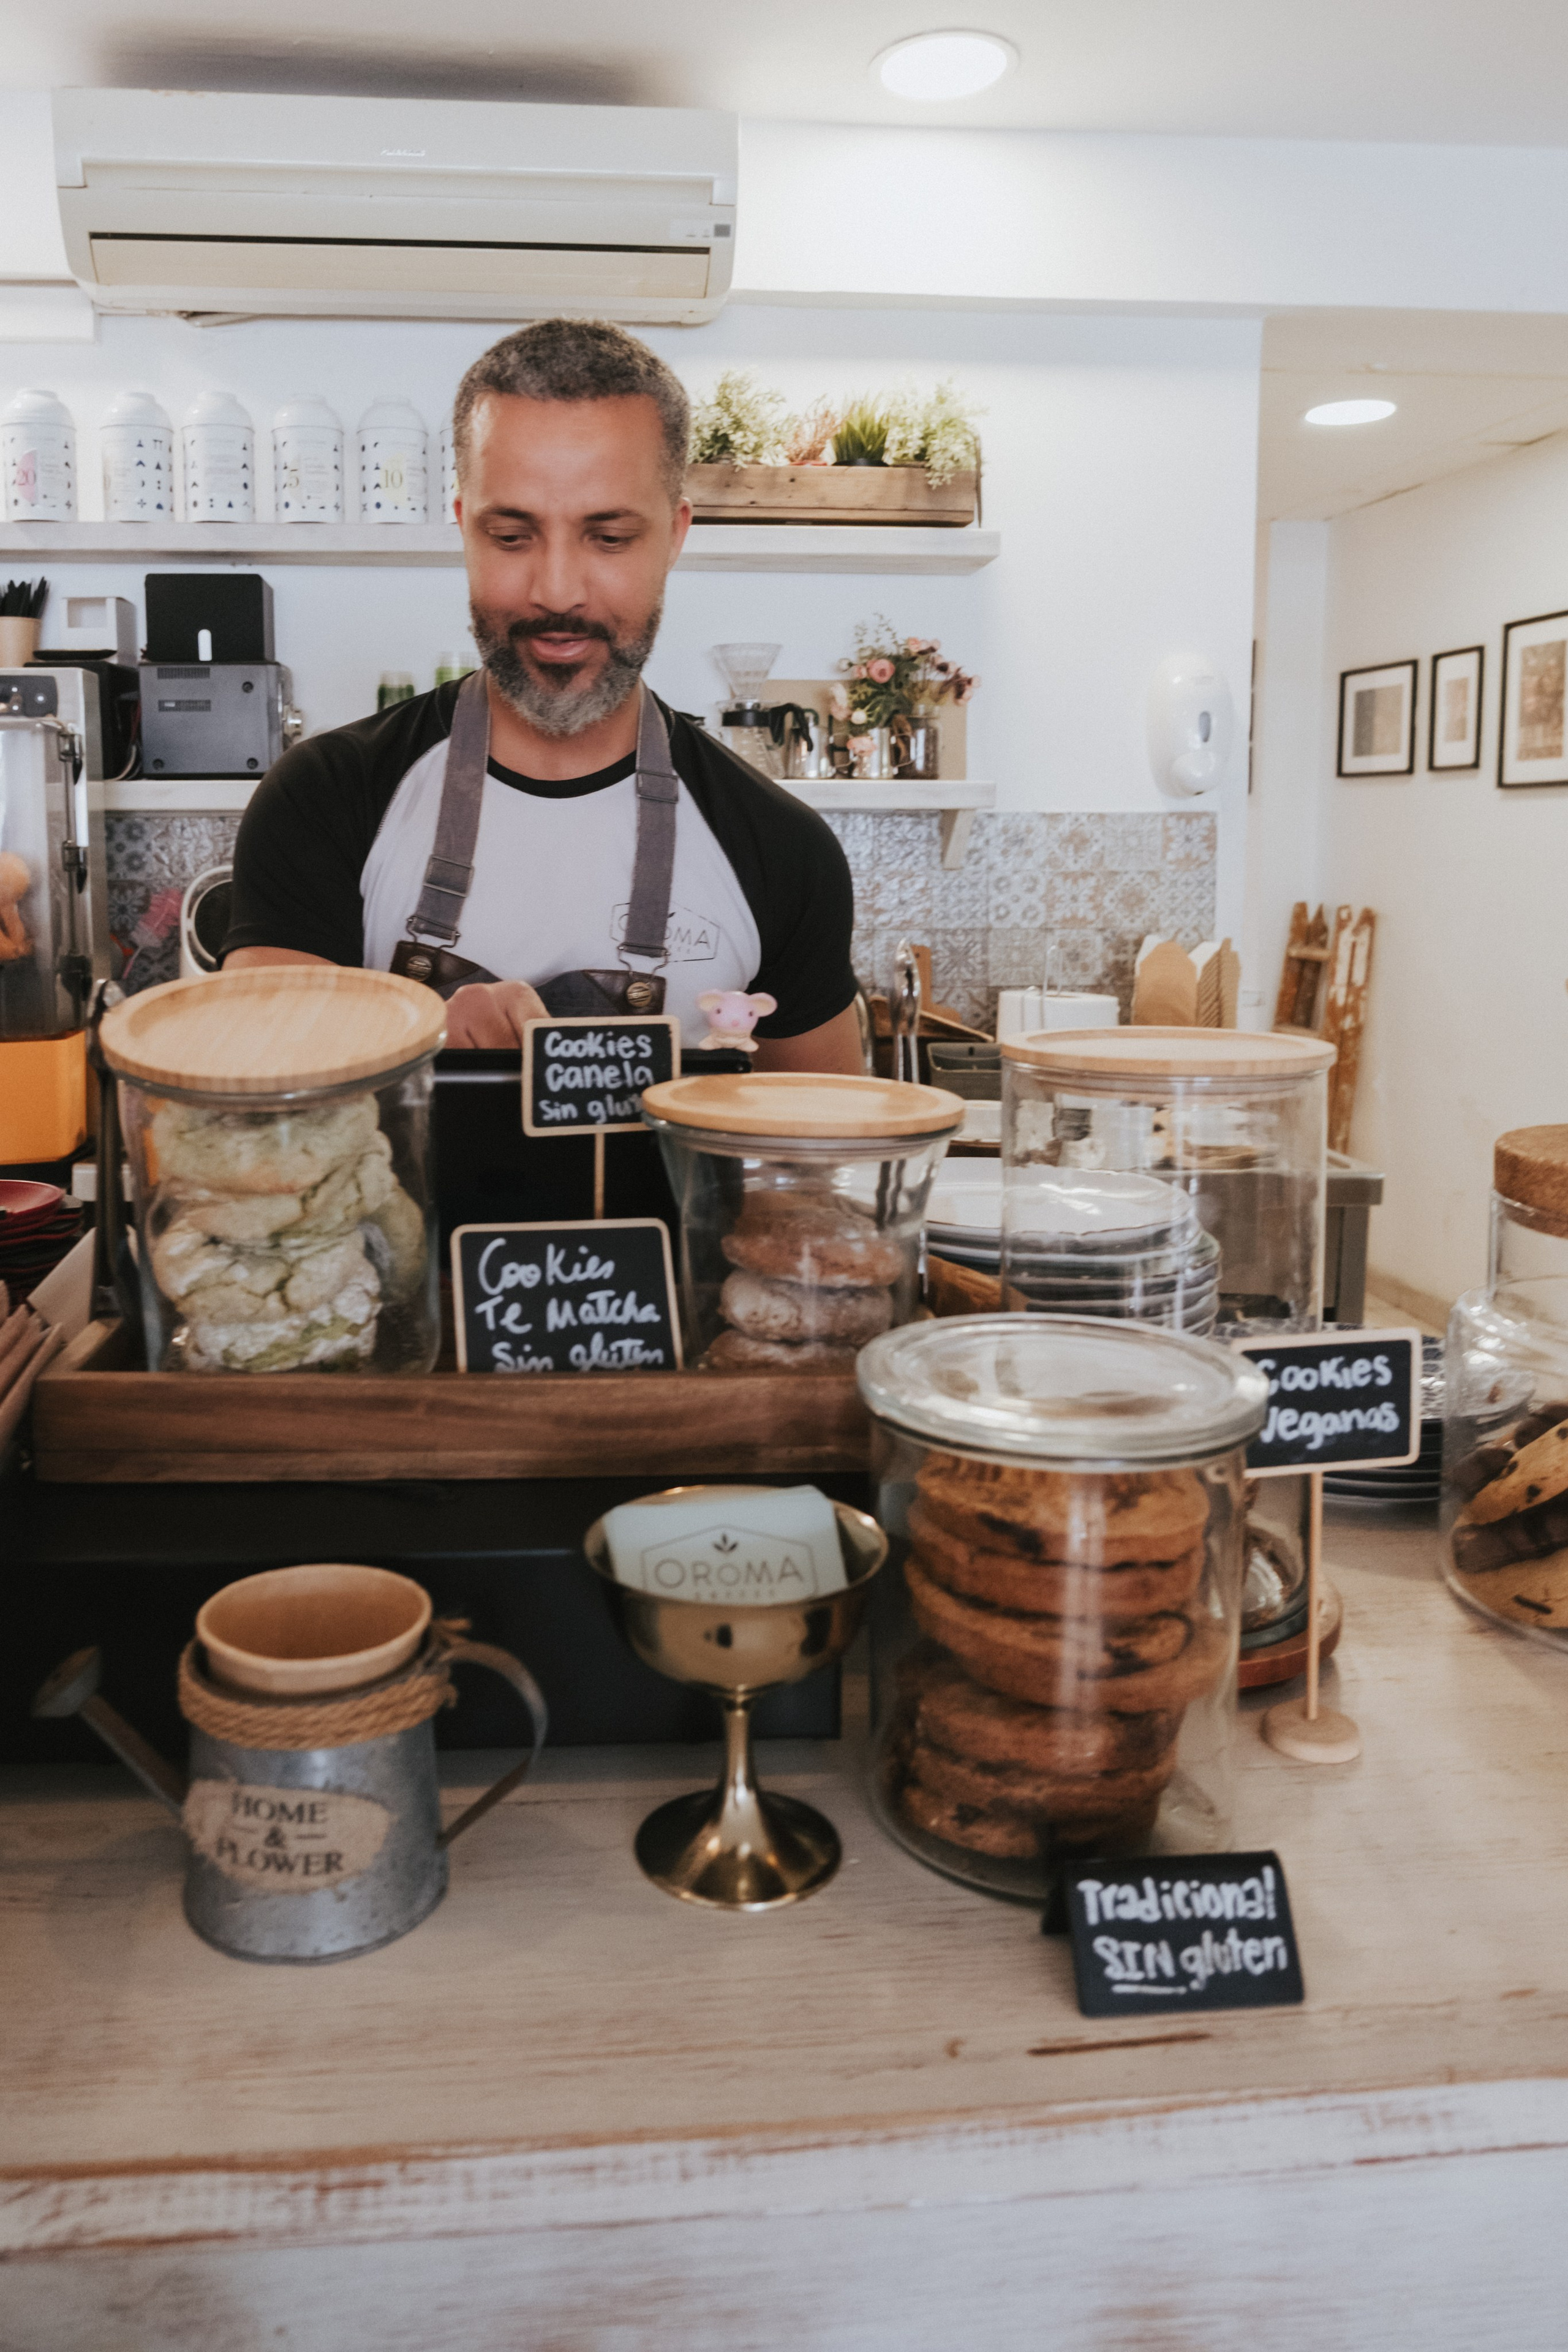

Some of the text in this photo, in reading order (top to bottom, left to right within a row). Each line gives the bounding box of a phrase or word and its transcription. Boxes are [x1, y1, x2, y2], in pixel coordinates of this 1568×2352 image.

[384, 469, 403, 489] 10
[617, 913, 710, 949] OMA
[545, 1063, 654, 1092] Canela
[538, 1099, 578, 1120] Sin
[474, 1295, 532, 1334] Te
[492, 1341, 553, 1373] Sin
[654, 1556, 804, 1589] OROMA
[232, 1790, 328, 1824] HOME
[264, 1826, 287, 1849] &
